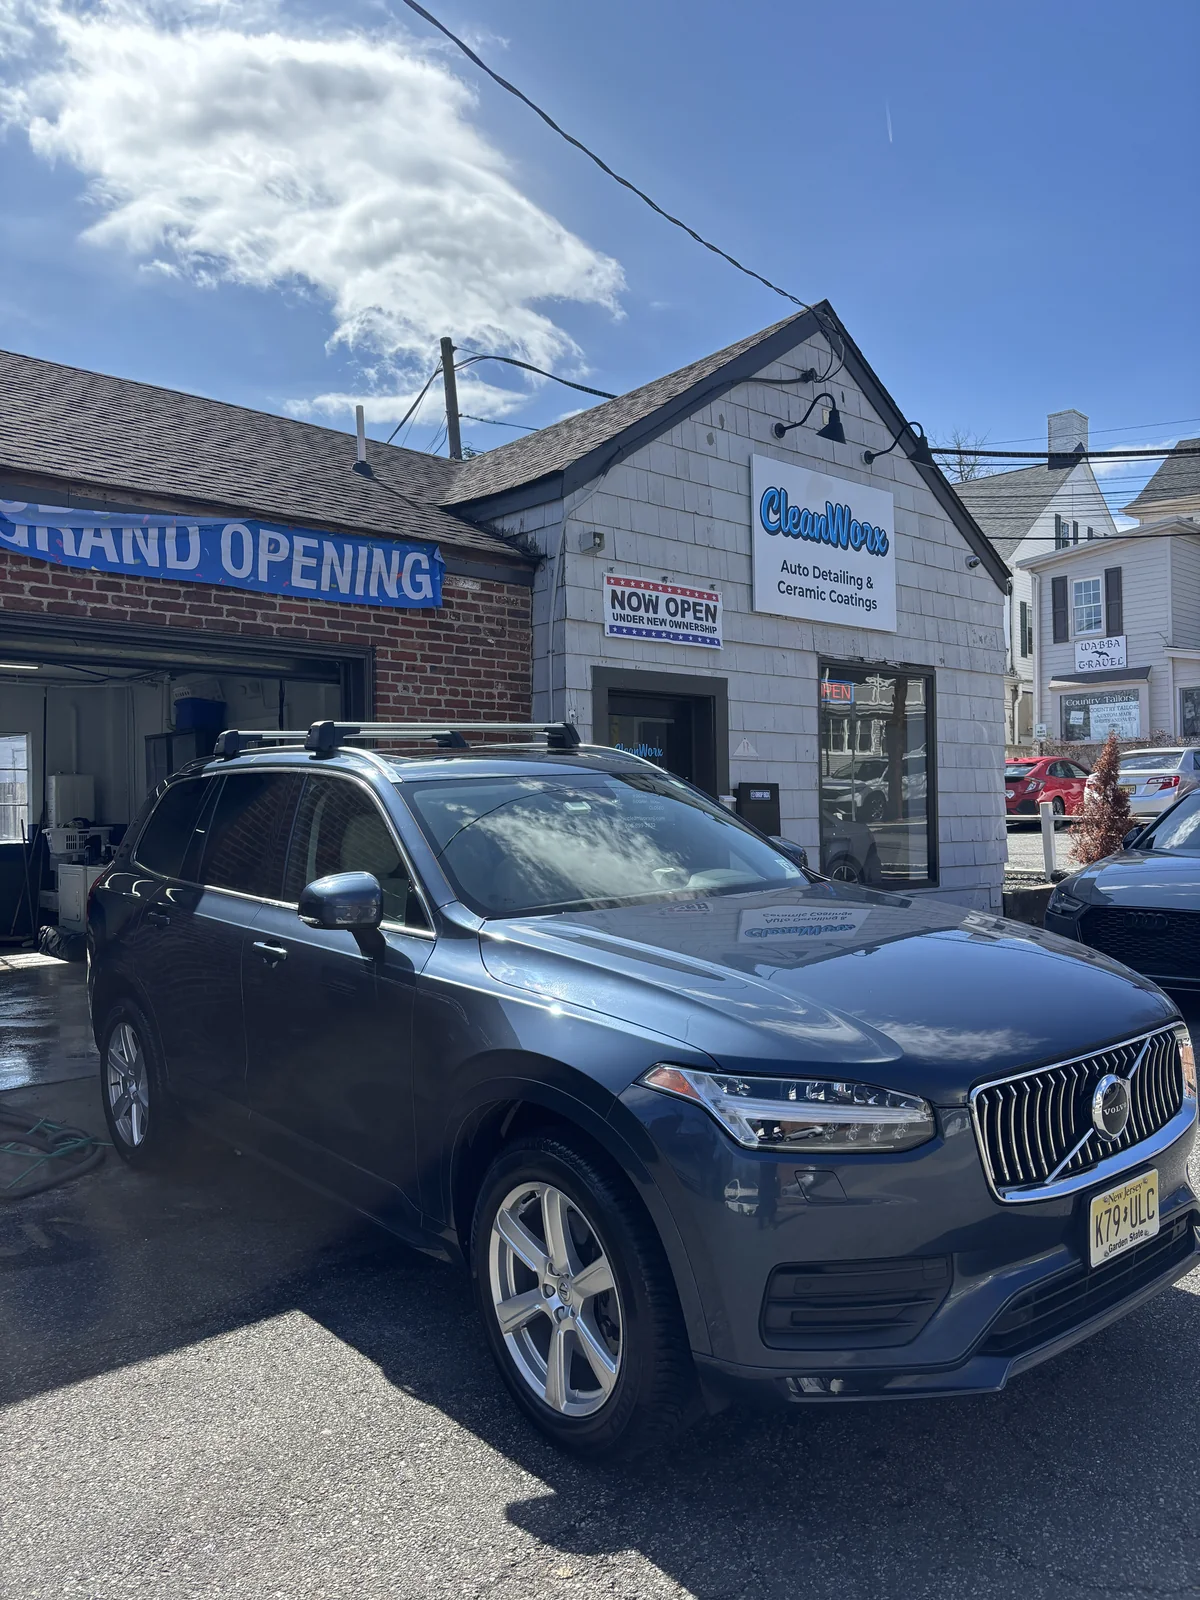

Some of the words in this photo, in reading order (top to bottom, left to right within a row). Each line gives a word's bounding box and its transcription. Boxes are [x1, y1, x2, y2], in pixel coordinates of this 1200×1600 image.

[760, 486, 889, 557] CleanWorx
[220, 523, 434, 600] OPENING
[780, 560, 809, 577] Auto
[812, 565, 863, 590] Detailing
[866, 576, 874, 589] &
[610, 589, 660, 615] NOW
[665, 597, 718, 624] OPEN
[777, 580, 826, 601] Ceramic
[829, 589, 878, 612] Coatings
[612, 612, 645, 625] UNDER
[646, 616, 667, 627] NEW
[668, 620, 718, 634] OWNERSHIP
[1078, 656, 1124, 669] TRAVEL
[821, 683, 851, 699] PEN
[1065, 697, 1101, 706] Country
[1103, 694, 1134, 703] Tailors
[1103, 1102, 1126, 1115] VOLVO
[1108, 1191, 1123, 1205] New
[1123, 1182, 1142, 1200] Jersey
[1108, 1237, 1128, 1253] Garden
[1129, 1229, 1144, 1242] State
